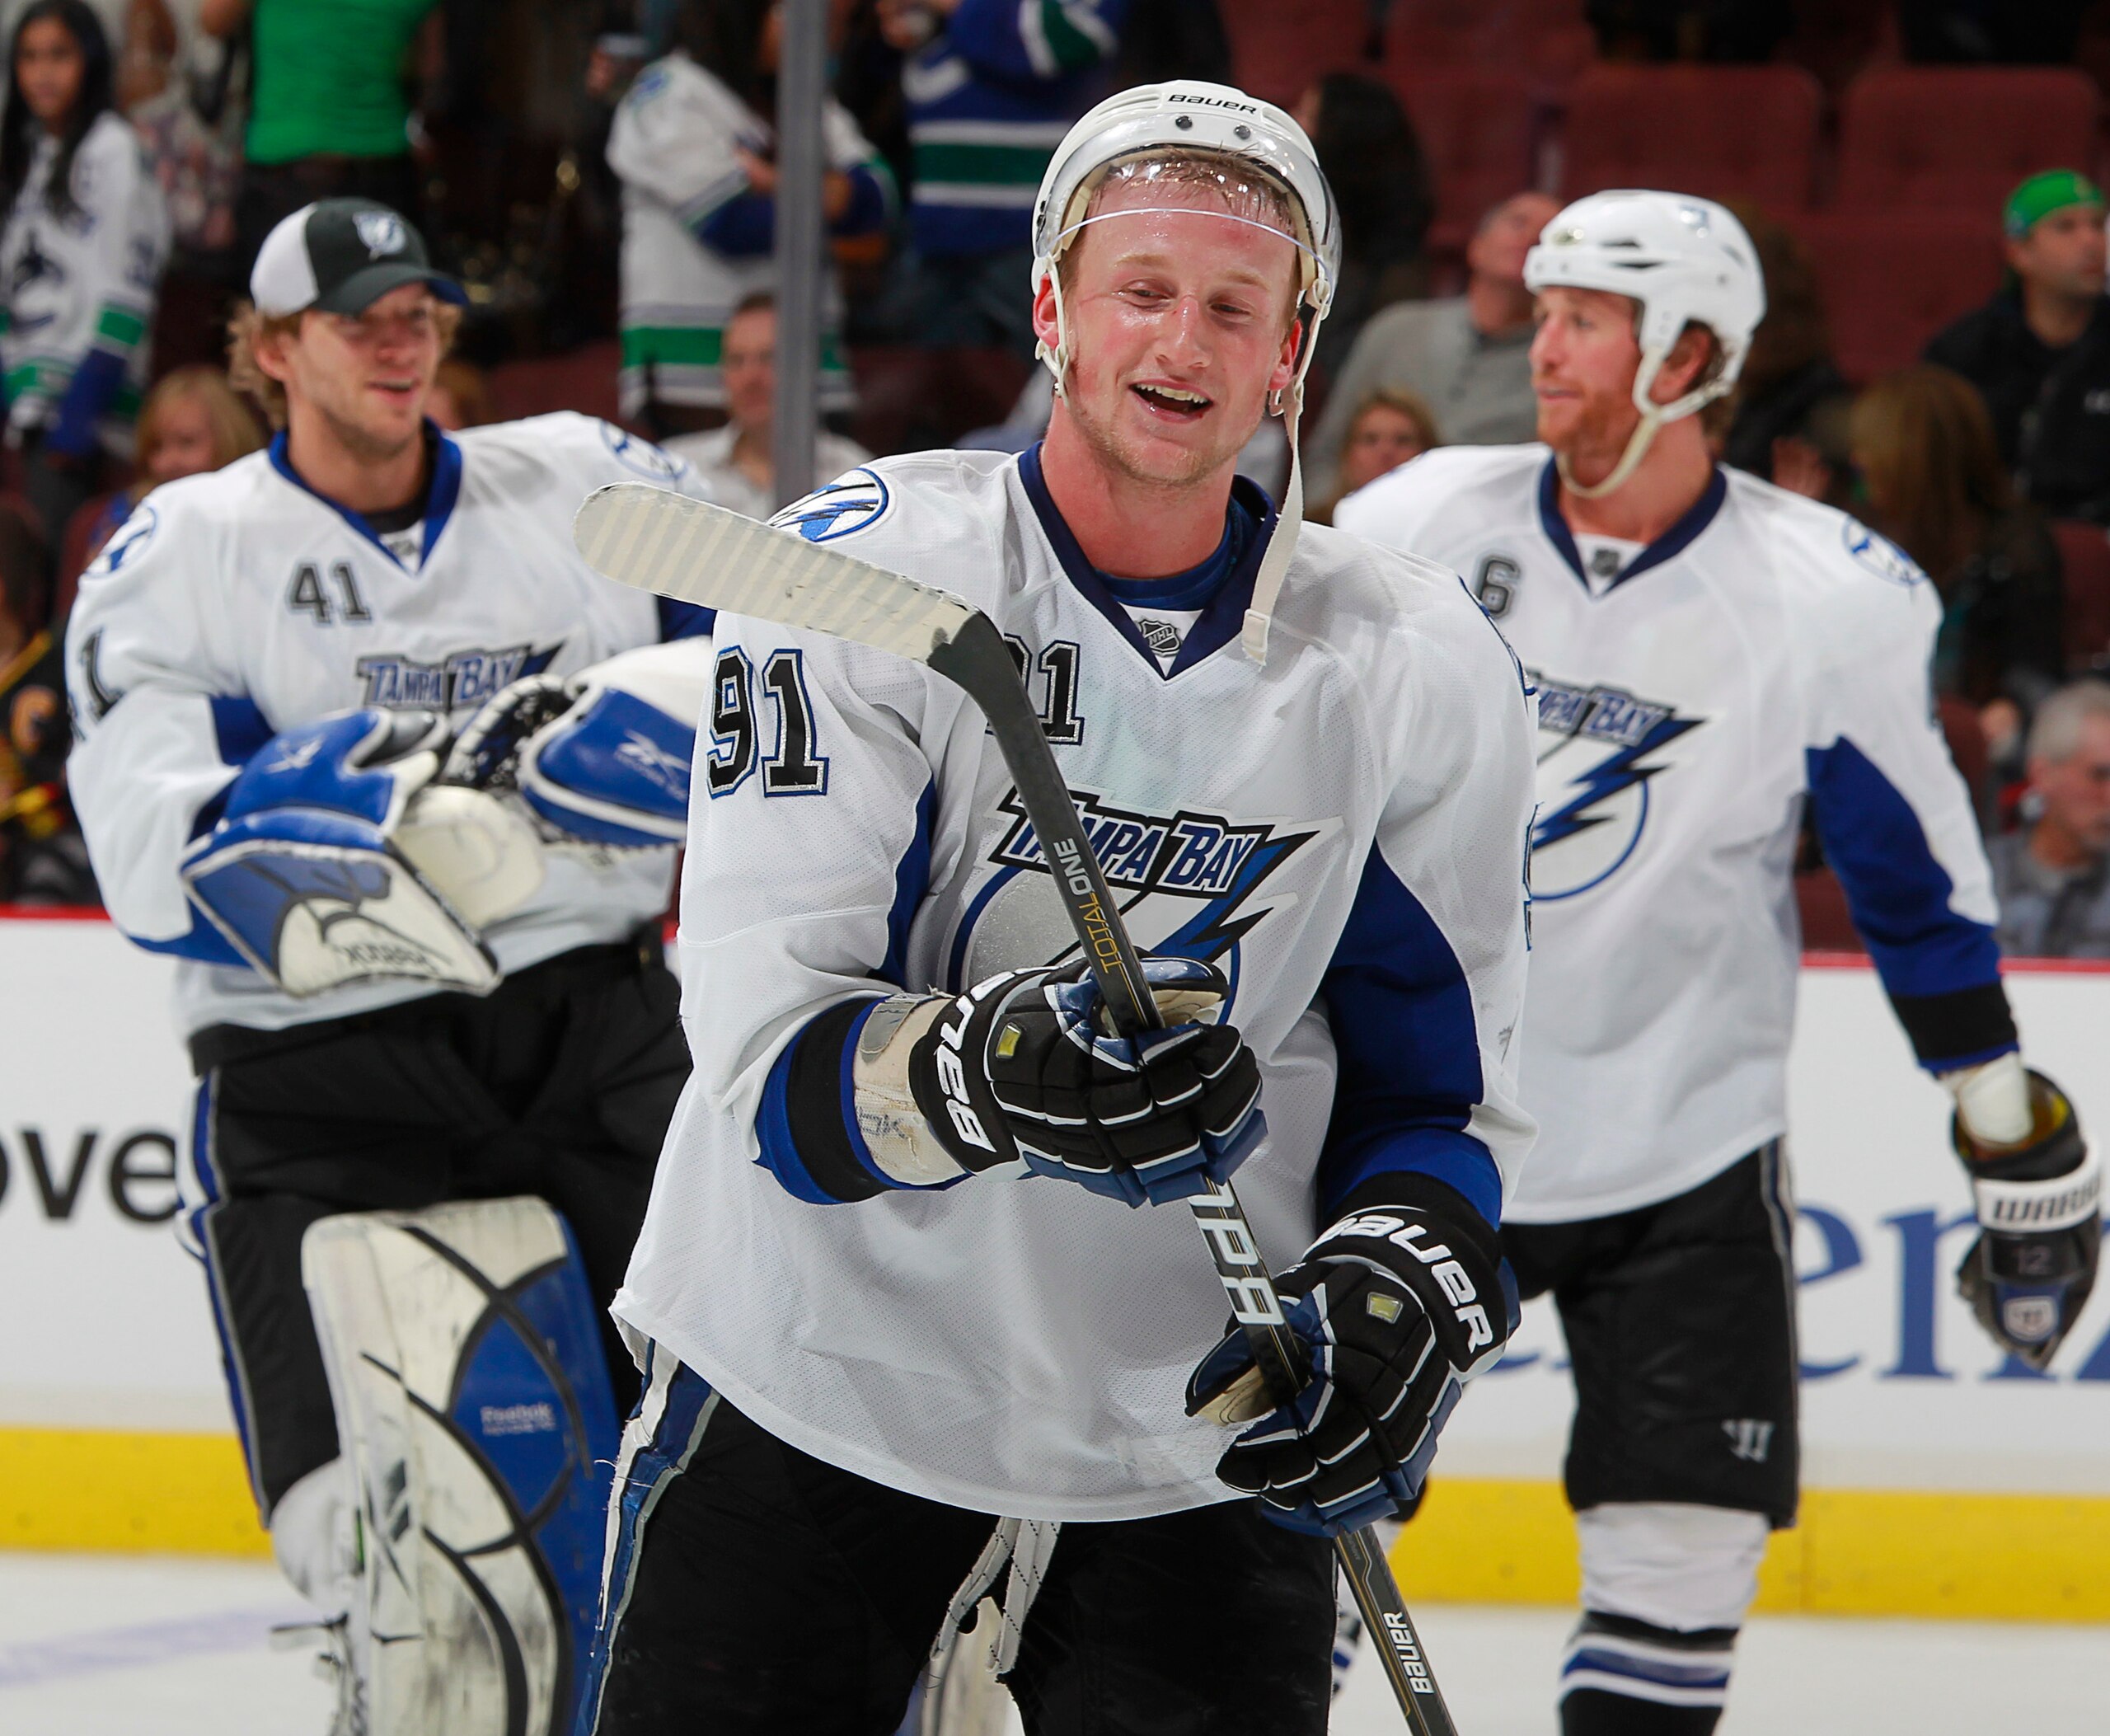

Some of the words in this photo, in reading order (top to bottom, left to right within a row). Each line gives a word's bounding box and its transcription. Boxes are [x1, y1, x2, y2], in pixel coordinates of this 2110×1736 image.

[284, 563, 373, 625] 41
[366, 661, 443, 706] TAMPA
[706, 645, 830, 800] 91
[1156, 819, 1263, 893] BAY
